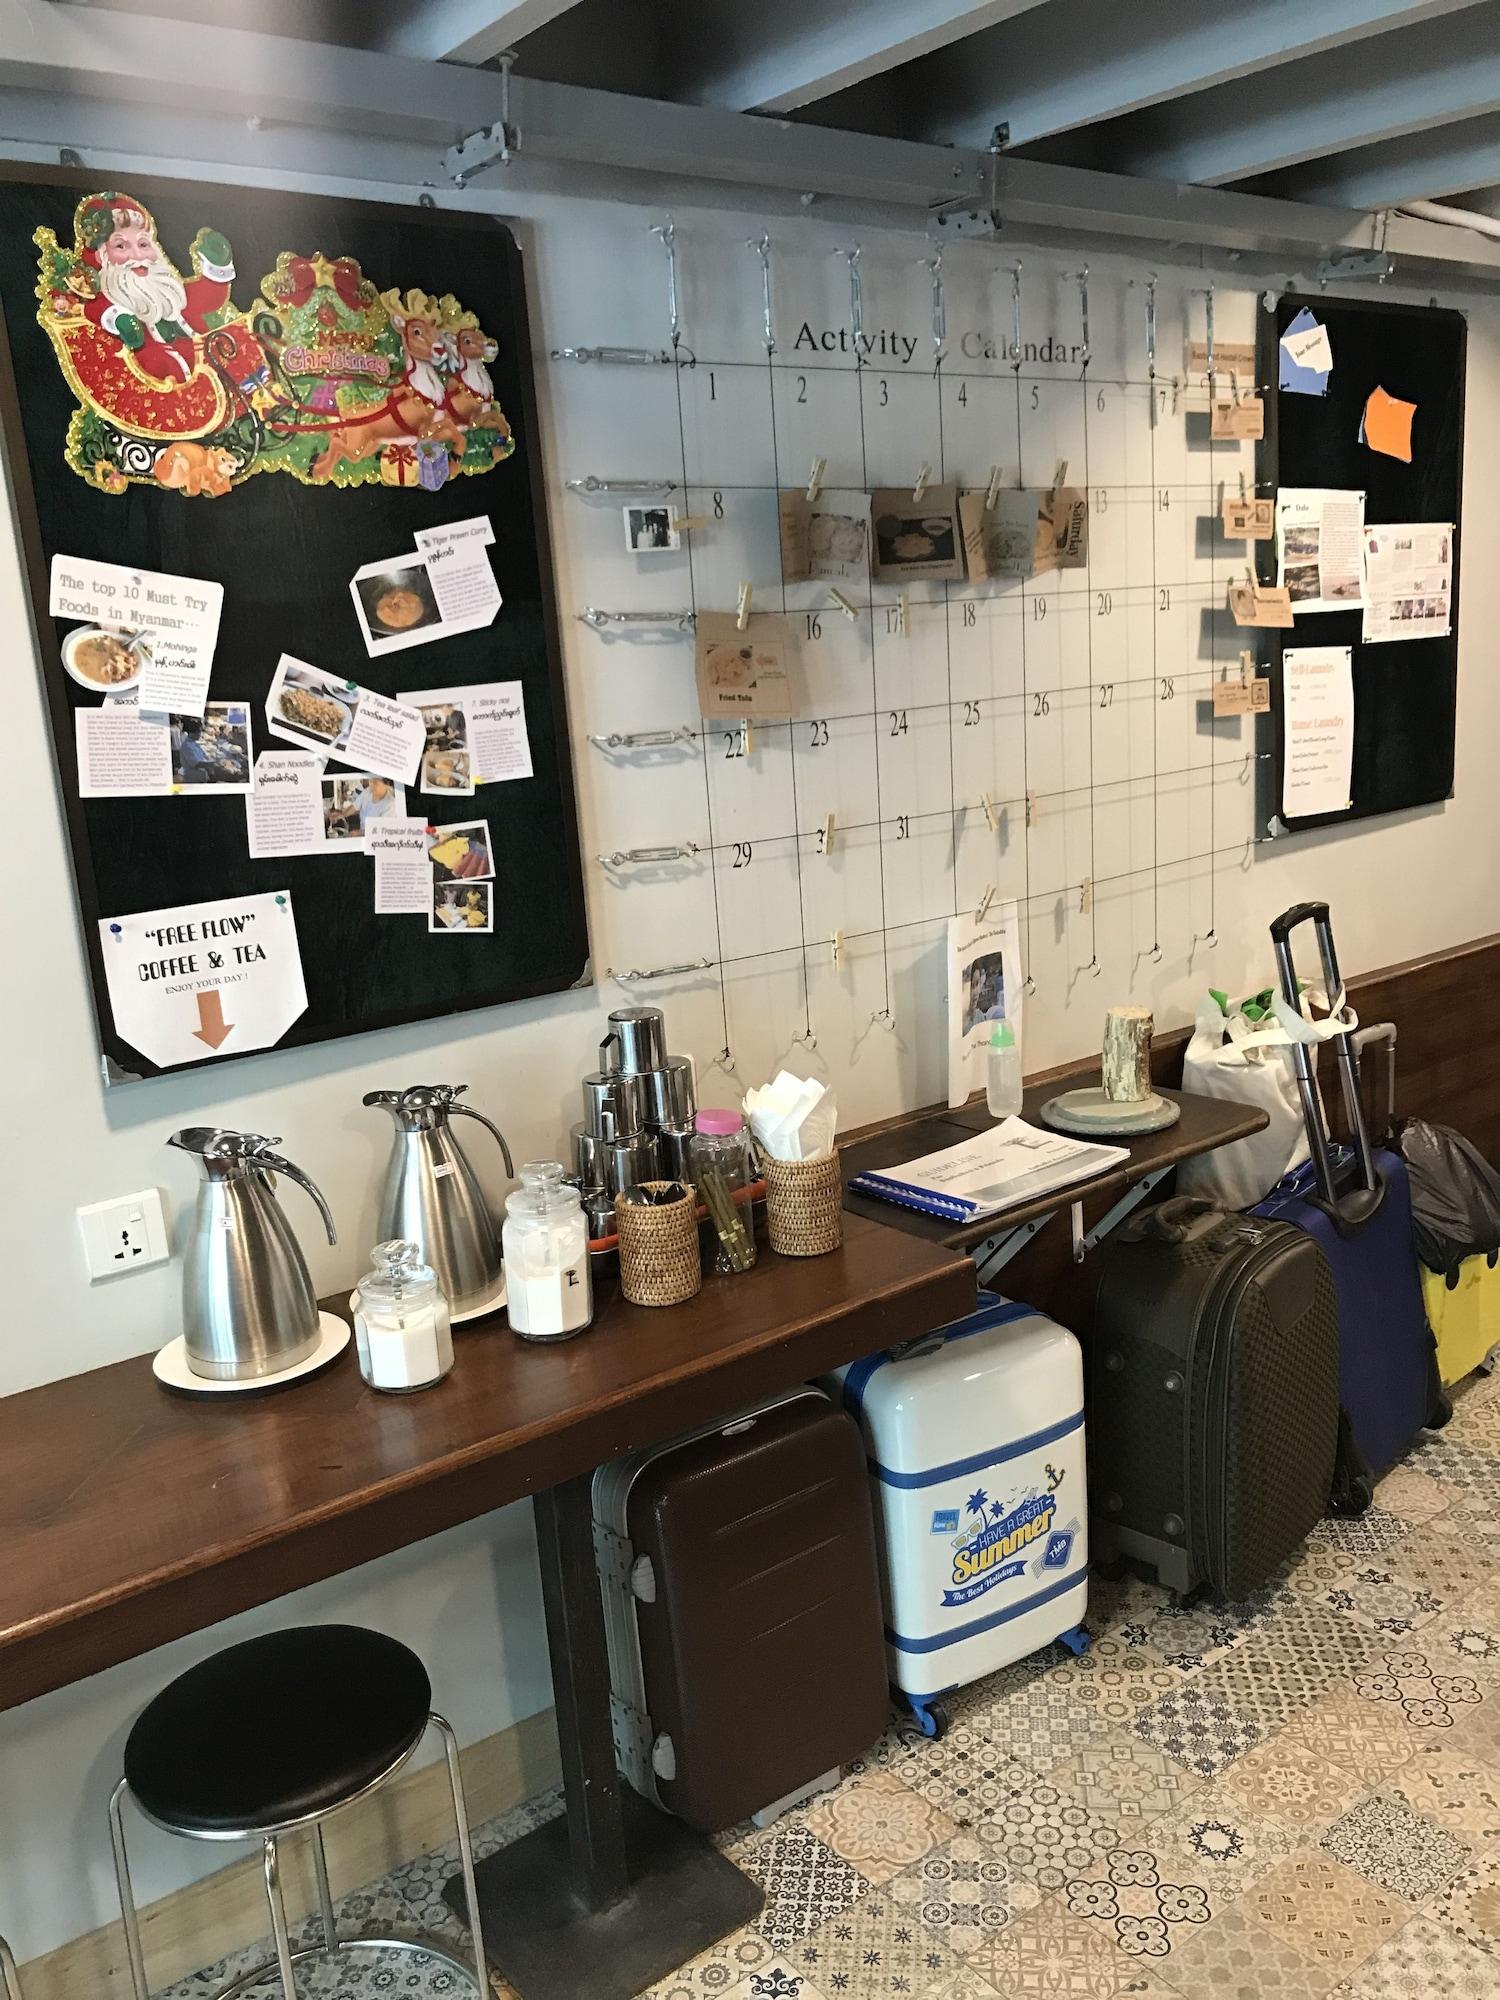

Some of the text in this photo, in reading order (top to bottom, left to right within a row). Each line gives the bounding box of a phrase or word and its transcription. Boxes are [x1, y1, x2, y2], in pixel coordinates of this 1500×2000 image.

[318, 330, 374, 349] Merry
[284, 345, 391, 377] Christmas
[709, 372, 1166, 413] 1 2 3 4 5 6 7
[713, 491, 724, 519] 8
[1095, 489, 1170, 513] 13 14
[1067, 500, 1086, 558] Saturday
[58, 597, 99, 617] Foods
[108, 606, 123, 620] in
[59, 574, 208, 613] The top 10 Must Try
[806, 588, 1171, 640] 16 17 18 19 20 21
[724, 678, 1174, 759] 22 23 24 25 26 27 28
[268, 760, 286, 770] Shan
[287, 759, 316, 768] Noodles
[732, 816, 910, 868] 29 3 31
[138, 943, 266, 981] COFFEE & TEA
[165, 982, 194, 995] ENJOY
[196, 977, 222, 989] YOUR
[224, 973, 243, 984] DAY
[978, 1500, 1045, 1548] HAVE A GREAT
[952, 1507, 1055, 1584] Summer
[1048, 1538, 1067, 1559] TMB
[952, 1565, 1018, 1601] The Best Holidays
